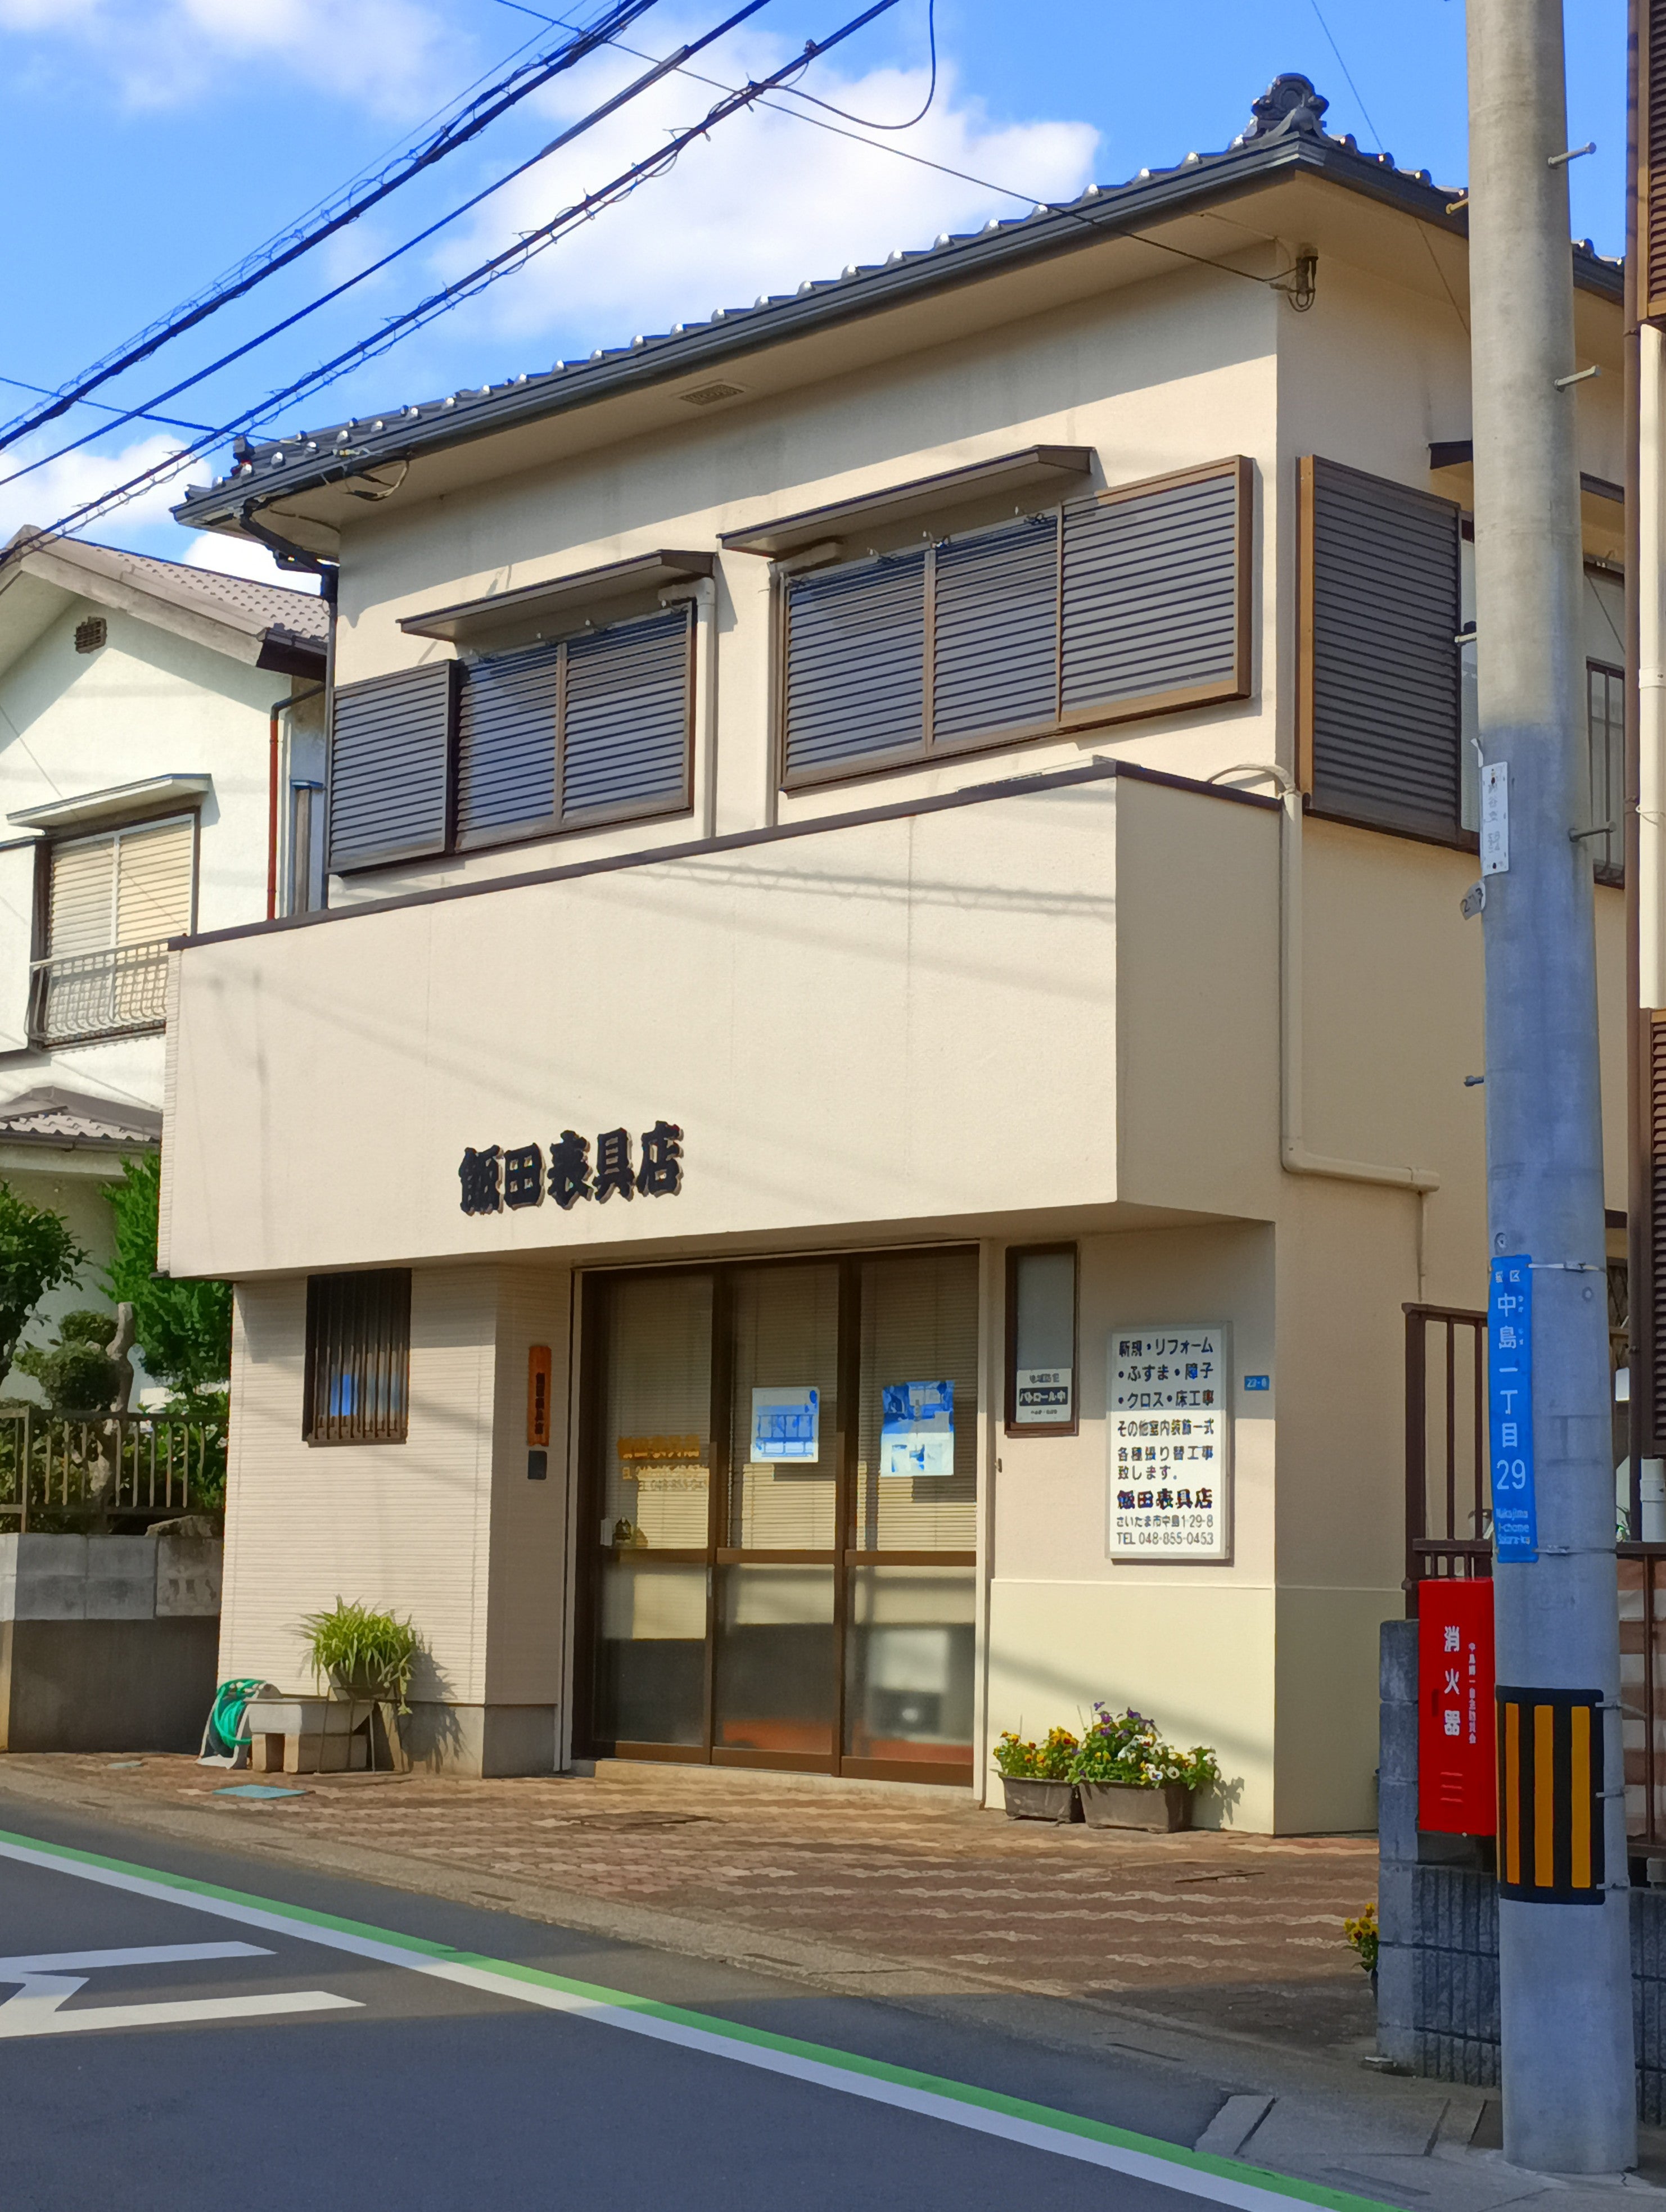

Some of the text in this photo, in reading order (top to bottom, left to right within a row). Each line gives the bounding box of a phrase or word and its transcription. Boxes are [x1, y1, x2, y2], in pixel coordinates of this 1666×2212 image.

[458, 1120, 684, 1216] 飯田表具店
[1497, 1292, 1518, 1448] 中島一丁目
[1117, 1487, 1213, 1510] 飯田表具店
[1496, 1459, 1526, 1490] 29
[1117, 1532, 1135, 1545] TEL
[1444, 1625, 1460, 1735] 消火器
